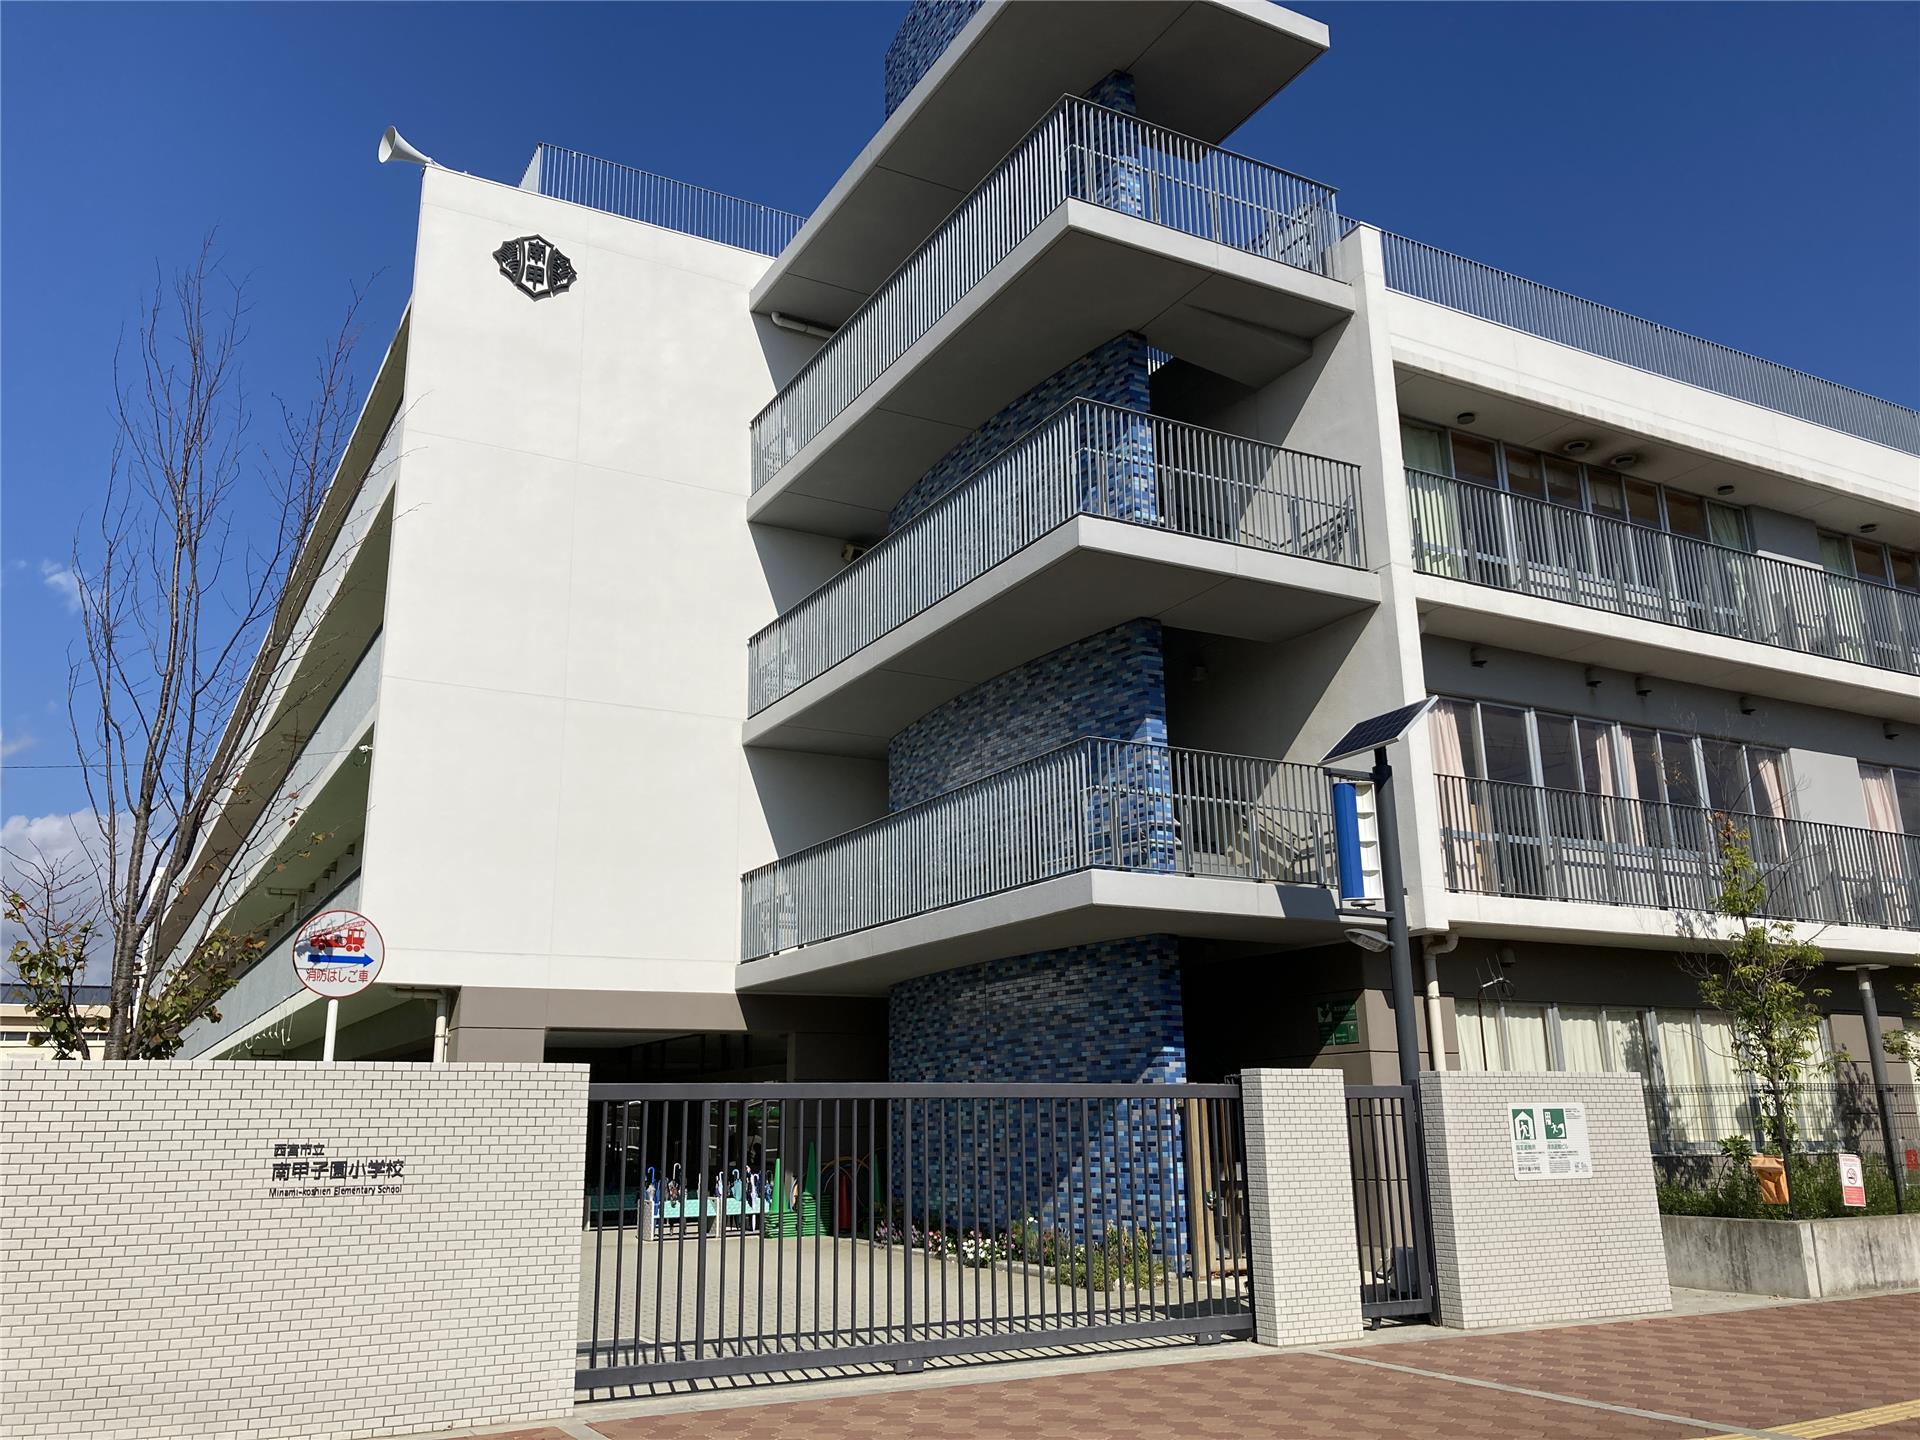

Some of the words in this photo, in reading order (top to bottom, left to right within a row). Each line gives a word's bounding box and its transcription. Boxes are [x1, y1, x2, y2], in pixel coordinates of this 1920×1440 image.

[306, 969, 368, 983] 消防はしご車
[274, 1143, 325, 1157] 西宮市立
[272, 1159, 404, 1181] 南甲子園小学校
[269, 1187, 331, 1198] Minami-koshien
[334, 1185, 376, 1197] Elementary
[377, 1184, 402, 1195] School
